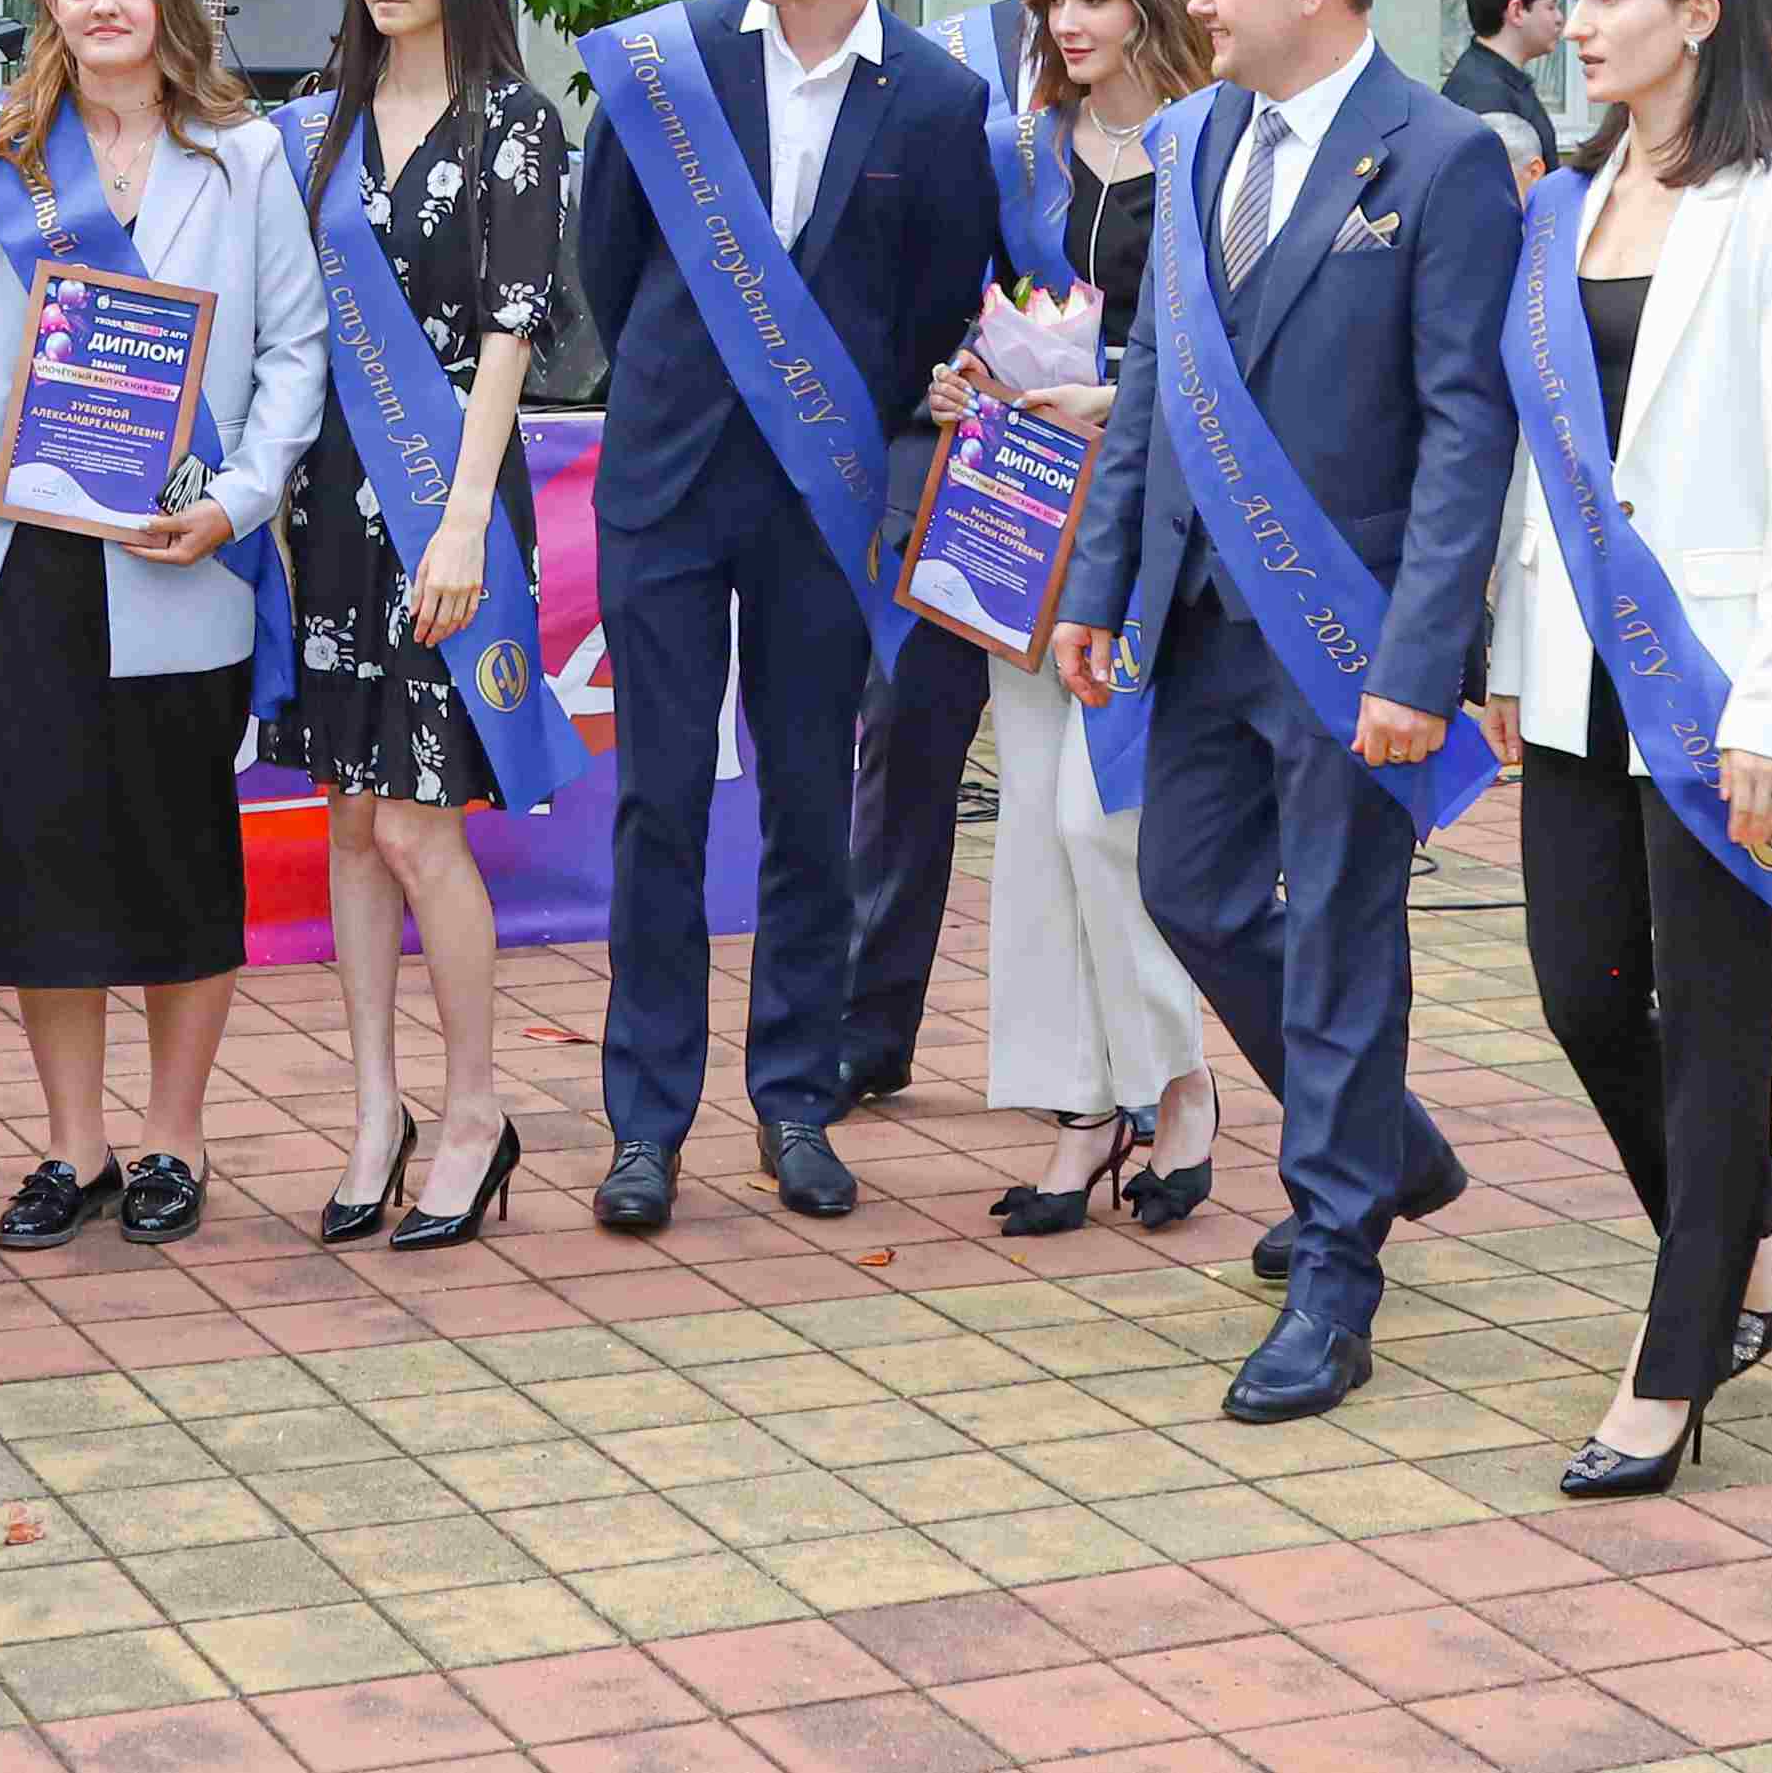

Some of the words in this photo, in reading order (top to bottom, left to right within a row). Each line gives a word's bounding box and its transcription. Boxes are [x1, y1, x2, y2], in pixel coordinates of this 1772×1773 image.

[621, 32, 722, 207] Почетный
[705, 214, 788, 351] студент
[770, 357, 846, 426] АГУ
[87, 332, 186, 366] ДИПЛОМ
[90, 359, 128, 374] ЗВАНИЕ
[331, 285, 407, 427] студент
[388, 431, 452, 507] АГУ
[30, 406, 102, 428] АЛЕКСАНДРЕ
[102, 420, 166, 441] АНДРЕЕВНЕ
[995, 446, 1076, 495] ДИПЛОМ
[1528, 211, 1567, 405] Почетный
[1612, 594, 1682, 684] АГУ
[1174, 332, 1244, 485] студент
[1229, 495, 1318, 582] АГУ
[1306, 607, 1369, 676] 2023
